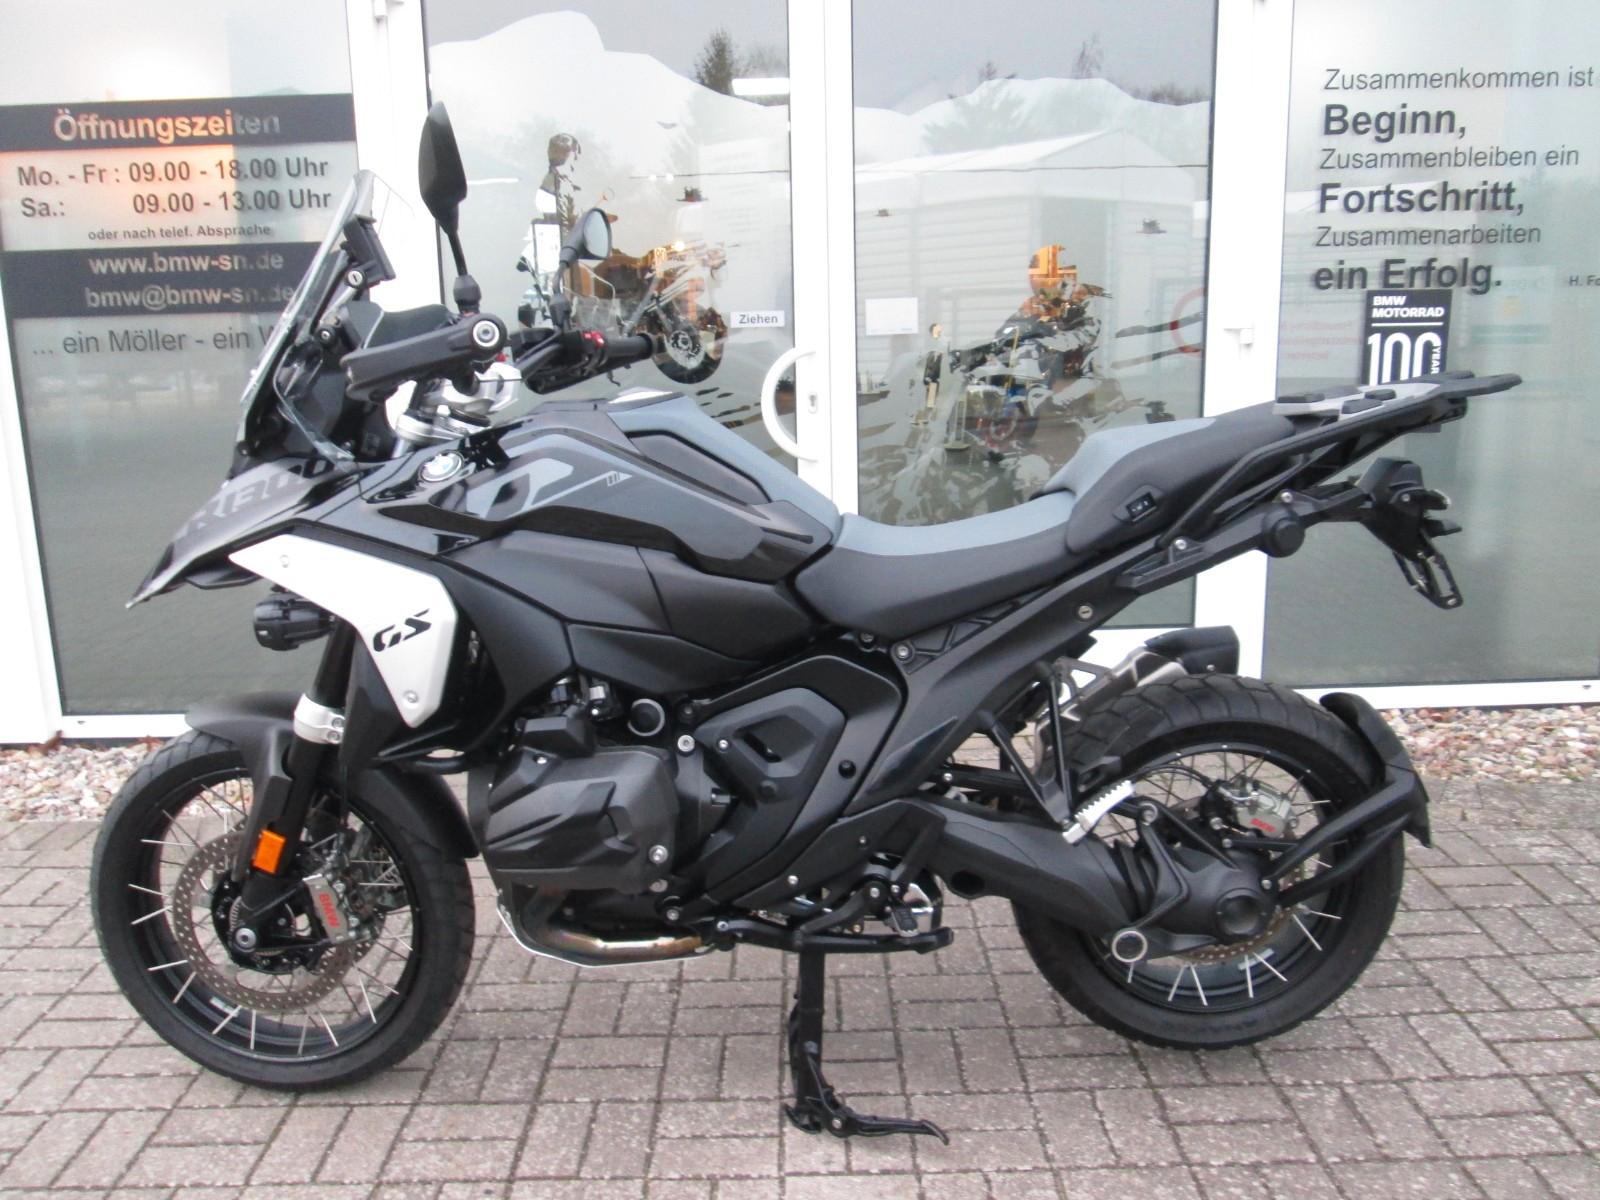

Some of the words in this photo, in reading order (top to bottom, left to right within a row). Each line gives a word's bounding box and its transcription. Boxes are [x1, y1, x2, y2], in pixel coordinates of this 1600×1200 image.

[1324, 67, 1559, 90] Zusammenkommen
[1567, 65, 1595, 87] ist
[53, 108, 281, 144] Öffnungszeiten
[1323, 103, 1467, 143] Beginn,
[1319, 146, 1536, 170] Zusammenbleiben
[1545, 145, 1580, 166] ein
[17, 165, 60, 186] Mo.
[128, 161, 191, 183] 09.00
[215, 157, 277, 180] 18.00
[285, 156, 329, 178] Uhr
[132, 192, 195, 214] 09.00
[218, 190, 281, 211] 13.00
[289, 188, 332, 210] Uhr
[1318, 181, 1524, 215] Fortschritt,
[88, 229, 119, 241] oder
[122, 227, 156, 239] nach
[159, 226, 193, 238] telef.
[196, 224, 272, 241] Absprache
[1314, 224, 1542, 248] Zusammenarbeiten
[88, 251, 285, 275] www.bmw-sn.de
[1312, 260, 1369, 291] ein
[1382, 257, 1503, 296] Erfolg.
[1372, 307, 1445, 318] MOTORRAD
[1373, 296, 1407, 305] BMW
[739, 315, 778, 324] Ziehen
[62, 331, 99, 354] ein
[108, 328, 187, 352] Möller
[213, 326, 250, 349] ein
[1367, 332, 1441, 386] 100
